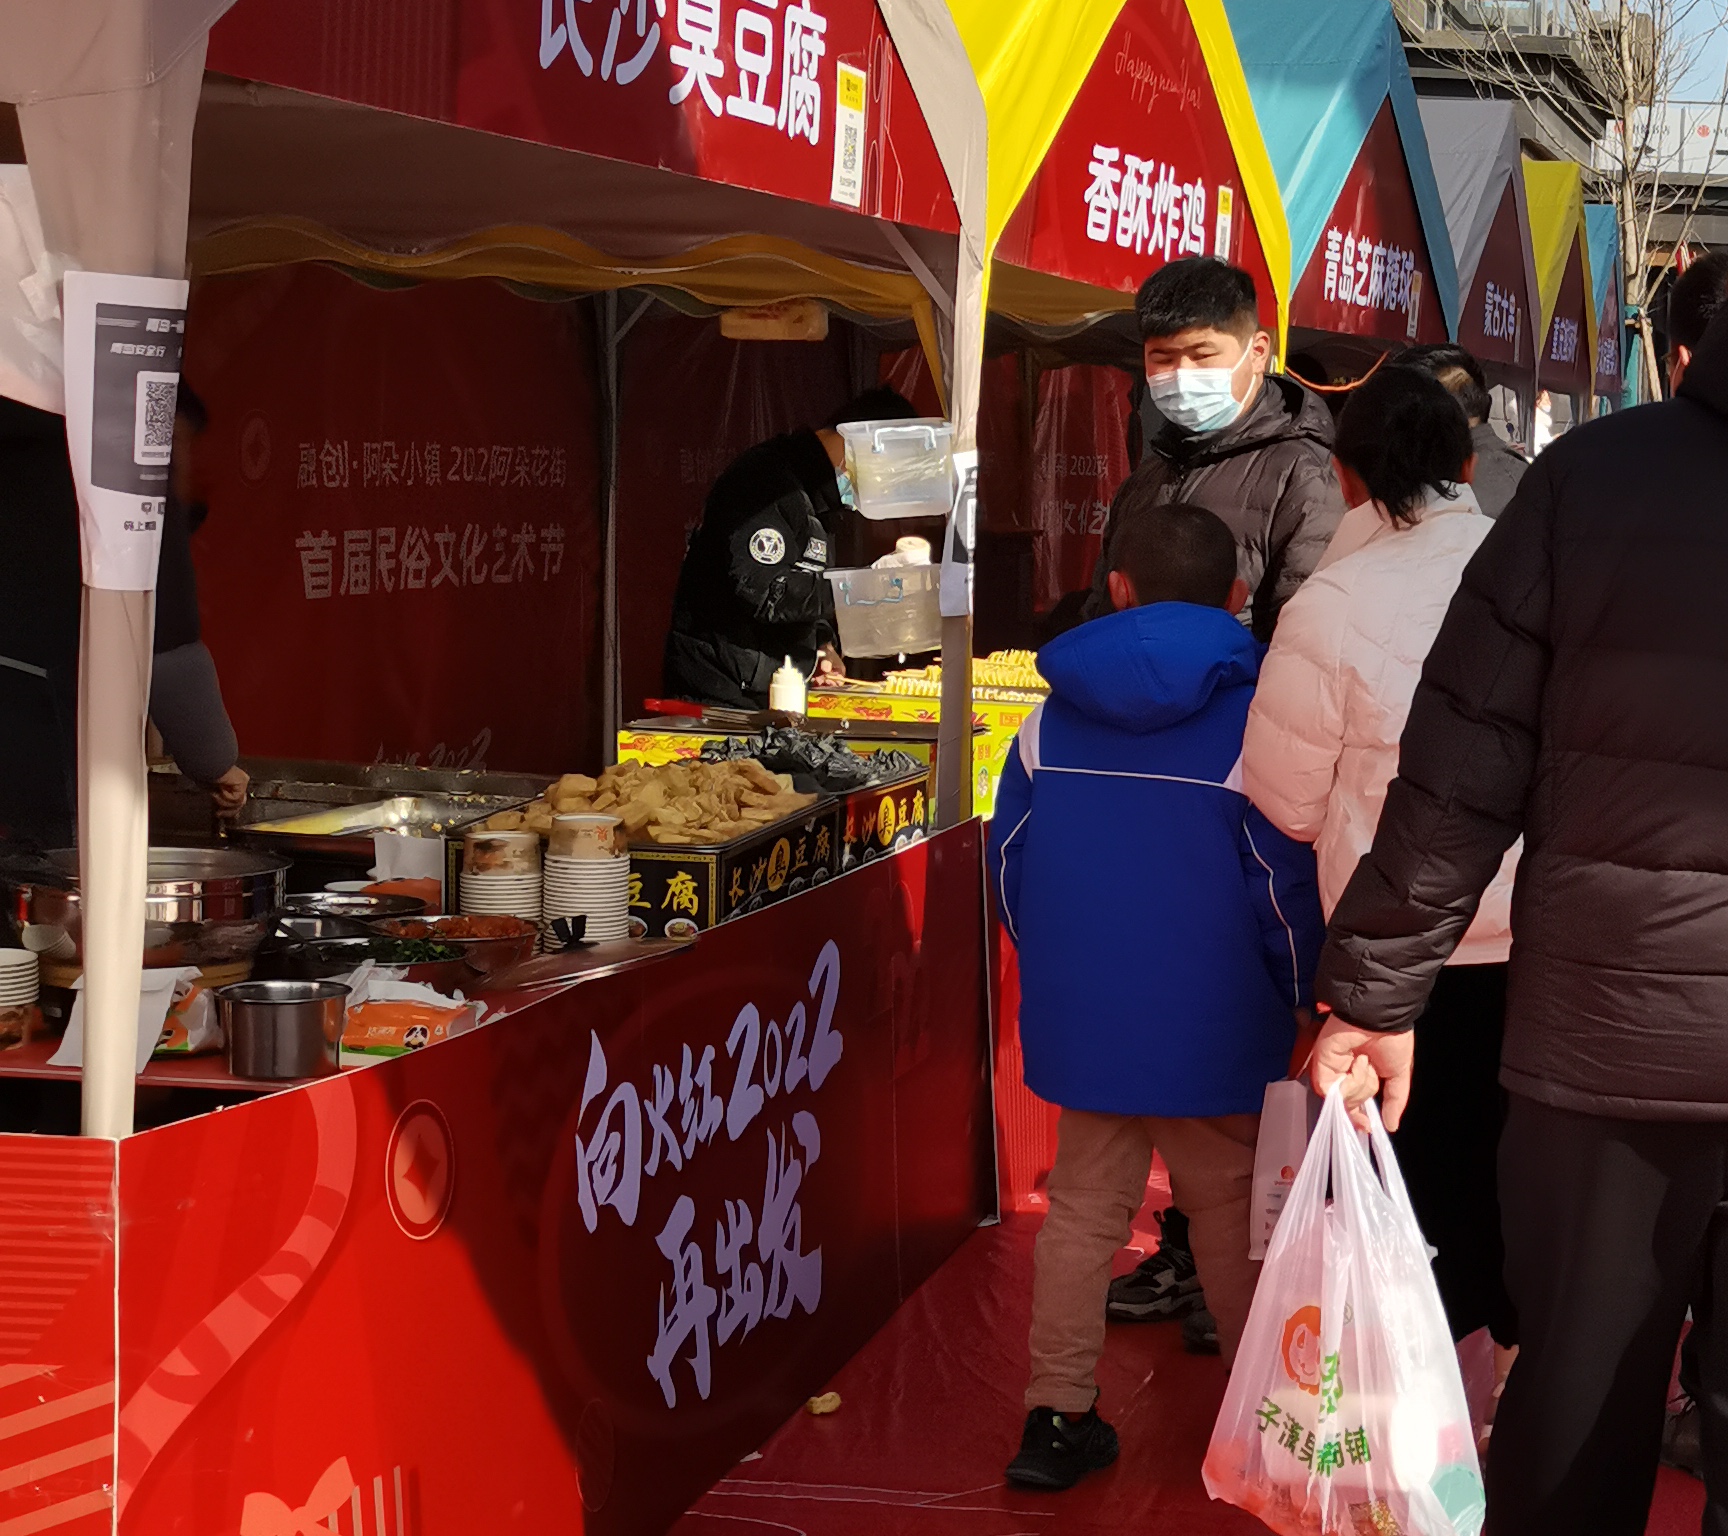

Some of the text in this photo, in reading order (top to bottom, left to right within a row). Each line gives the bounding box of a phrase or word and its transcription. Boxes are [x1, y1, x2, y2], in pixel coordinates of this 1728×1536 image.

[1084, 143, 1206, 262] 香酥炸鸡
[295, 522, 567, 601] 首届民俗文化艺术节
[843, 789, 925, 847] 长沙臭豆腐
[628, 870, 699, 916] 豆腐
[729, 825, 831, 908] 长沙臭豆腐
[575, 939, 844, 1234] 向火红2022
[646, 1110, 823, 1409] 再出发
